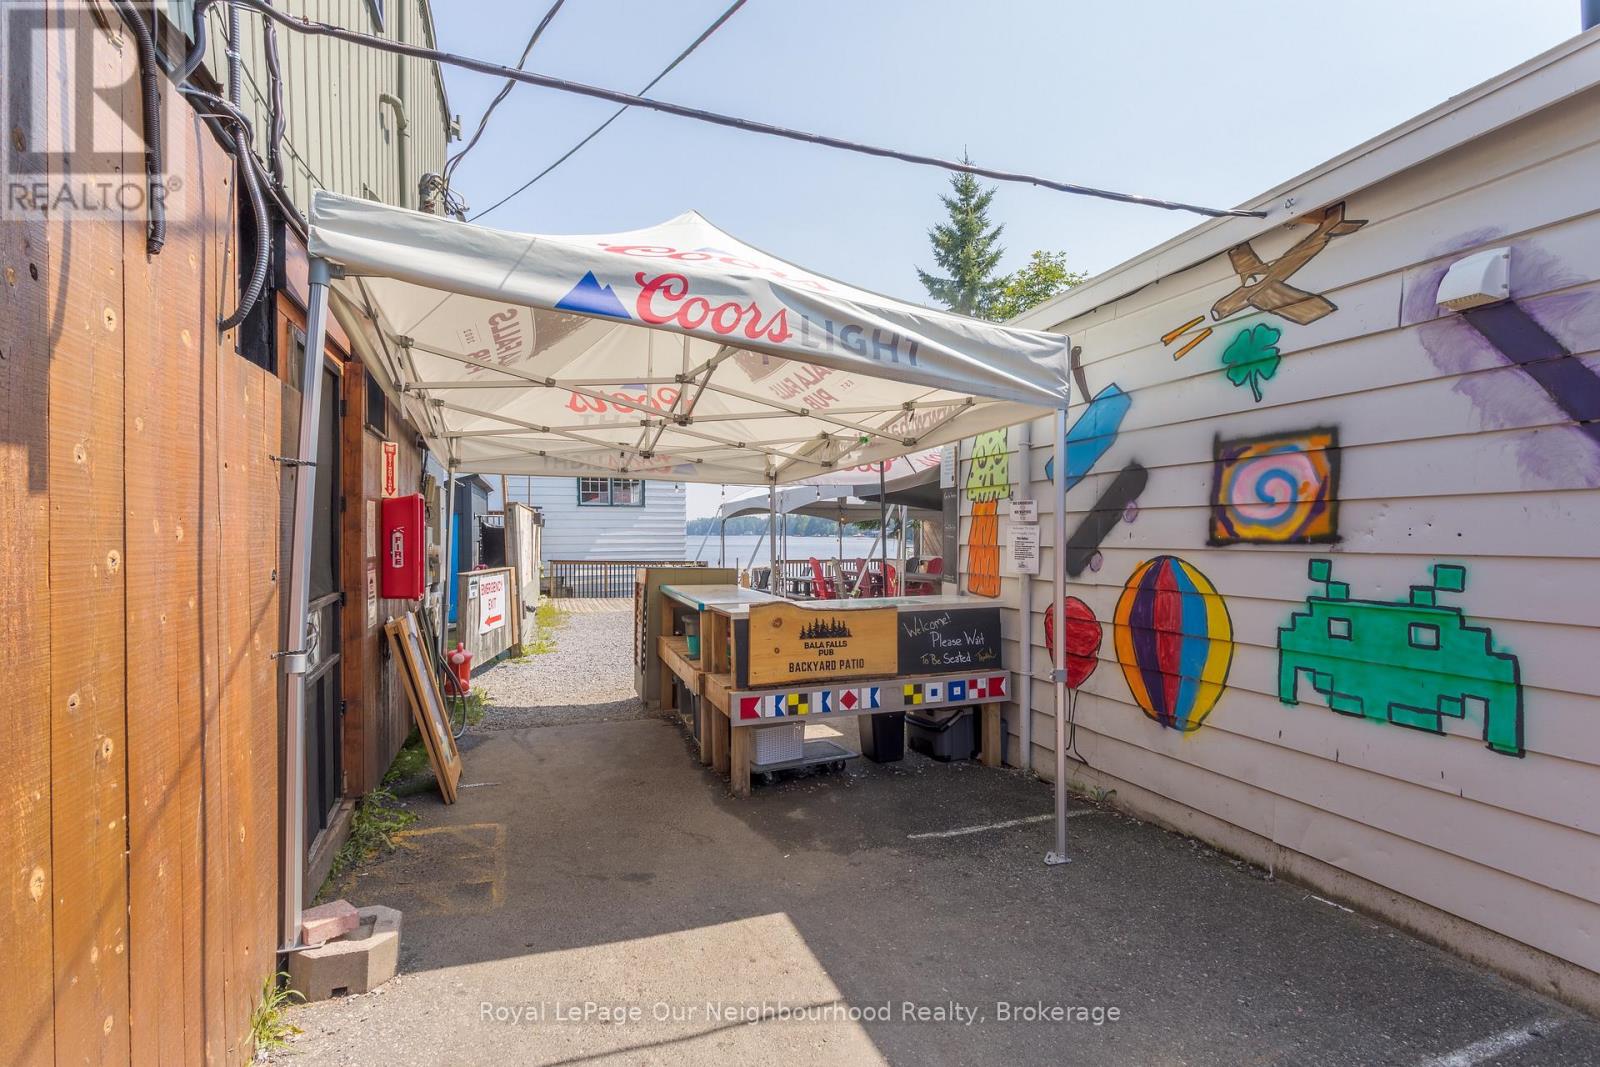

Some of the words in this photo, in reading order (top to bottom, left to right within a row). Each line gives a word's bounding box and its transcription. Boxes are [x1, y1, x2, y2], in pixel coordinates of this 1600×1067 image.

[635, 271, 792, 343] Coors
[801, 314, 921, 367] LIGHT
[480, 580, 503, 596] EMERGENCY
[487, 597, 497, 611] EXIT
[903, 612, 952, 638] Welcome!
[804, 641, 825, 649] BALA
[826, 640, 848, 648] FALLS
[929, 631, 963, 648] Please
[963, 628, 985, 645] Wait
[789, 660, 837, 673] BACKYARD
[839, 658, 865, 670] PATIO
[920, 653, 929, 665] To
[930, 653, 942, 665] Be
[943, 651, 972, 665] Seated
